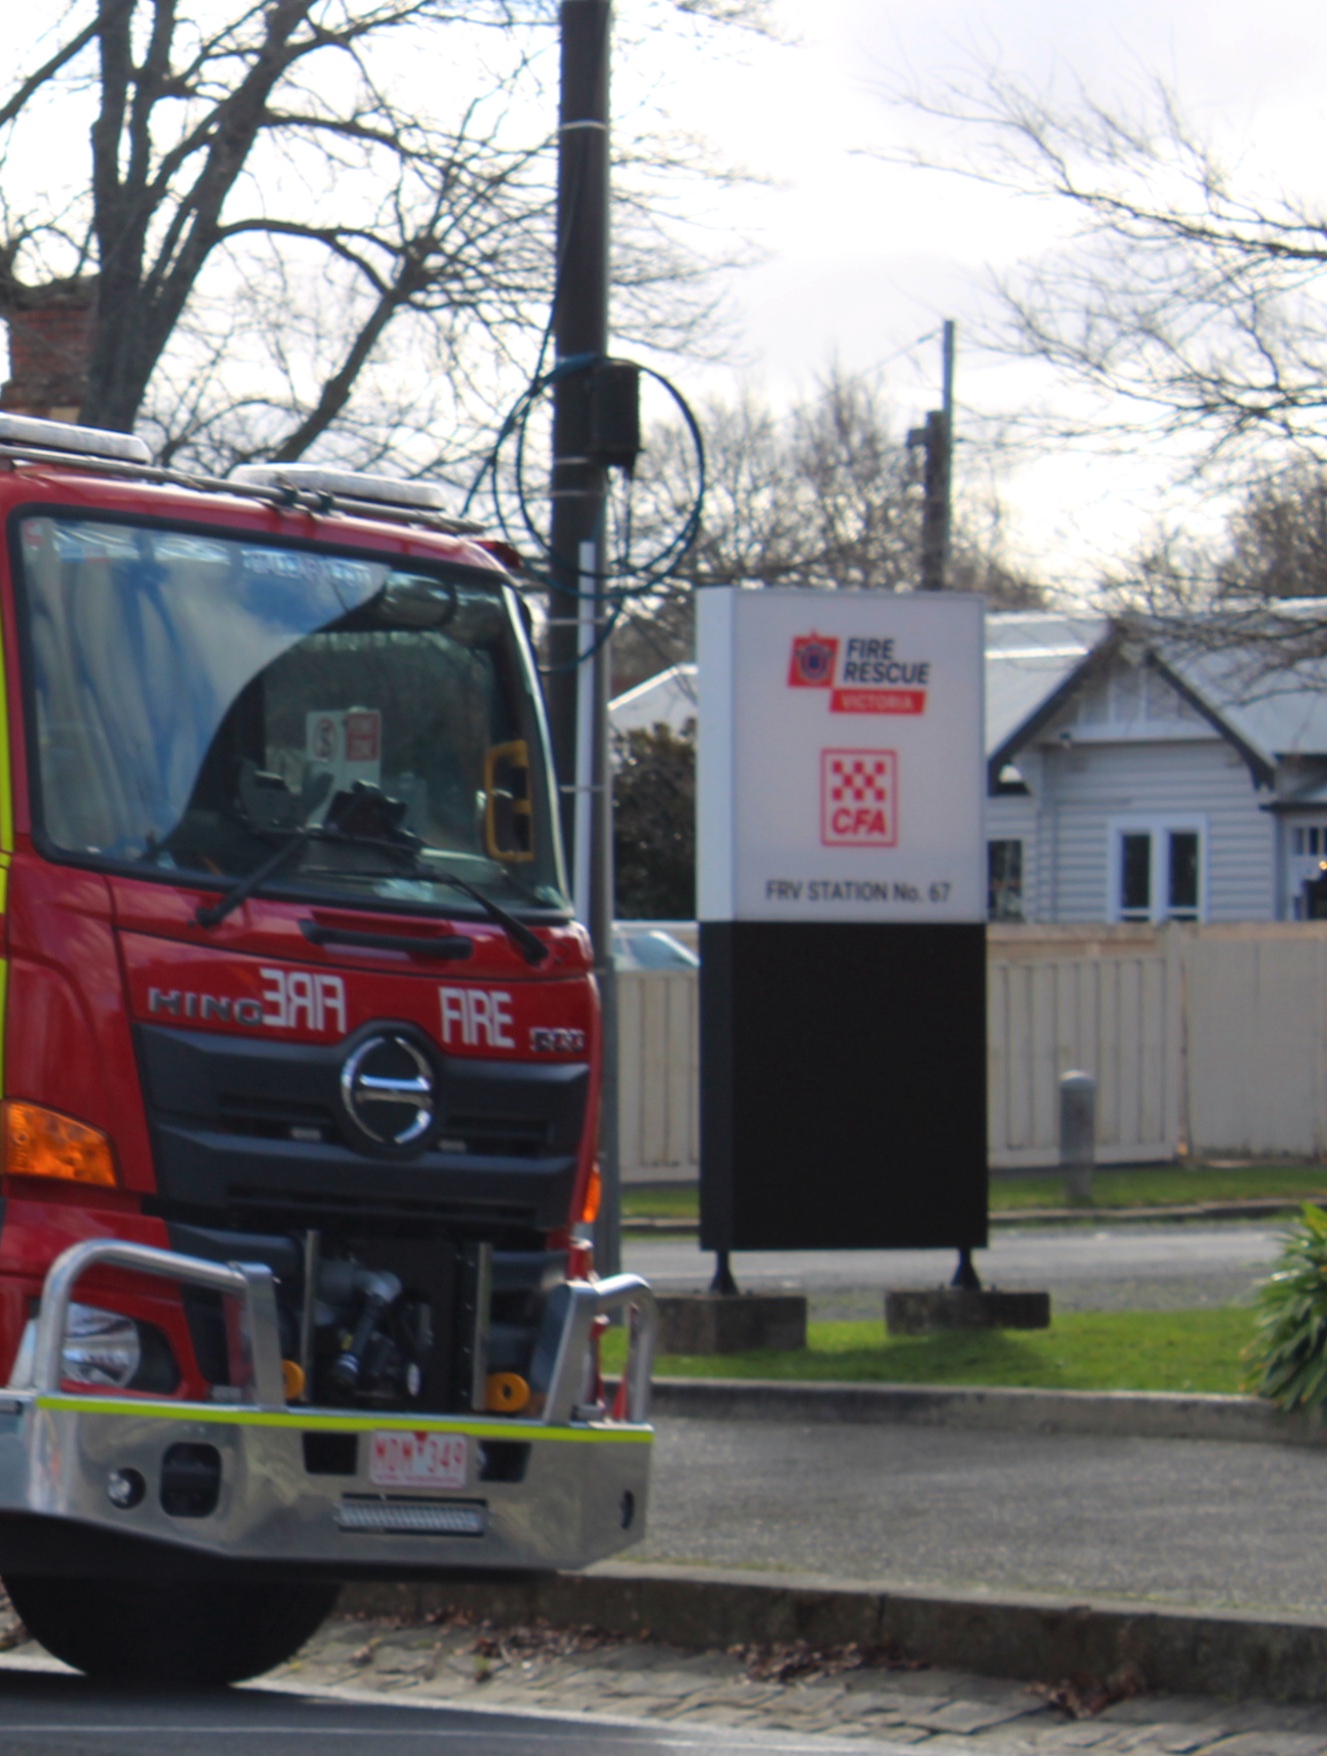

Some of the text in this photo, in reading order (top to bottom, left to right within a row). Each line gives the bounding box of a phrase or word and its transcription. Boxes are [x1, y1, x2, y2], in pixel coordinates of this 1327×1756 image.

[847, 637, 894, 660] FIRE
[844, 662, 930, 685] RESCUE
[841, 692, 914, 711] VICTORIA
[831, 807, 887, 836] CFA
[765, 879, 803, 901] FRV
[808, 880, 888, 902] STATION
[928, 882, 951, 903] 67
[148, 986, 264, 1027] HINO
[438, 985, 516, 1049] FIRE
